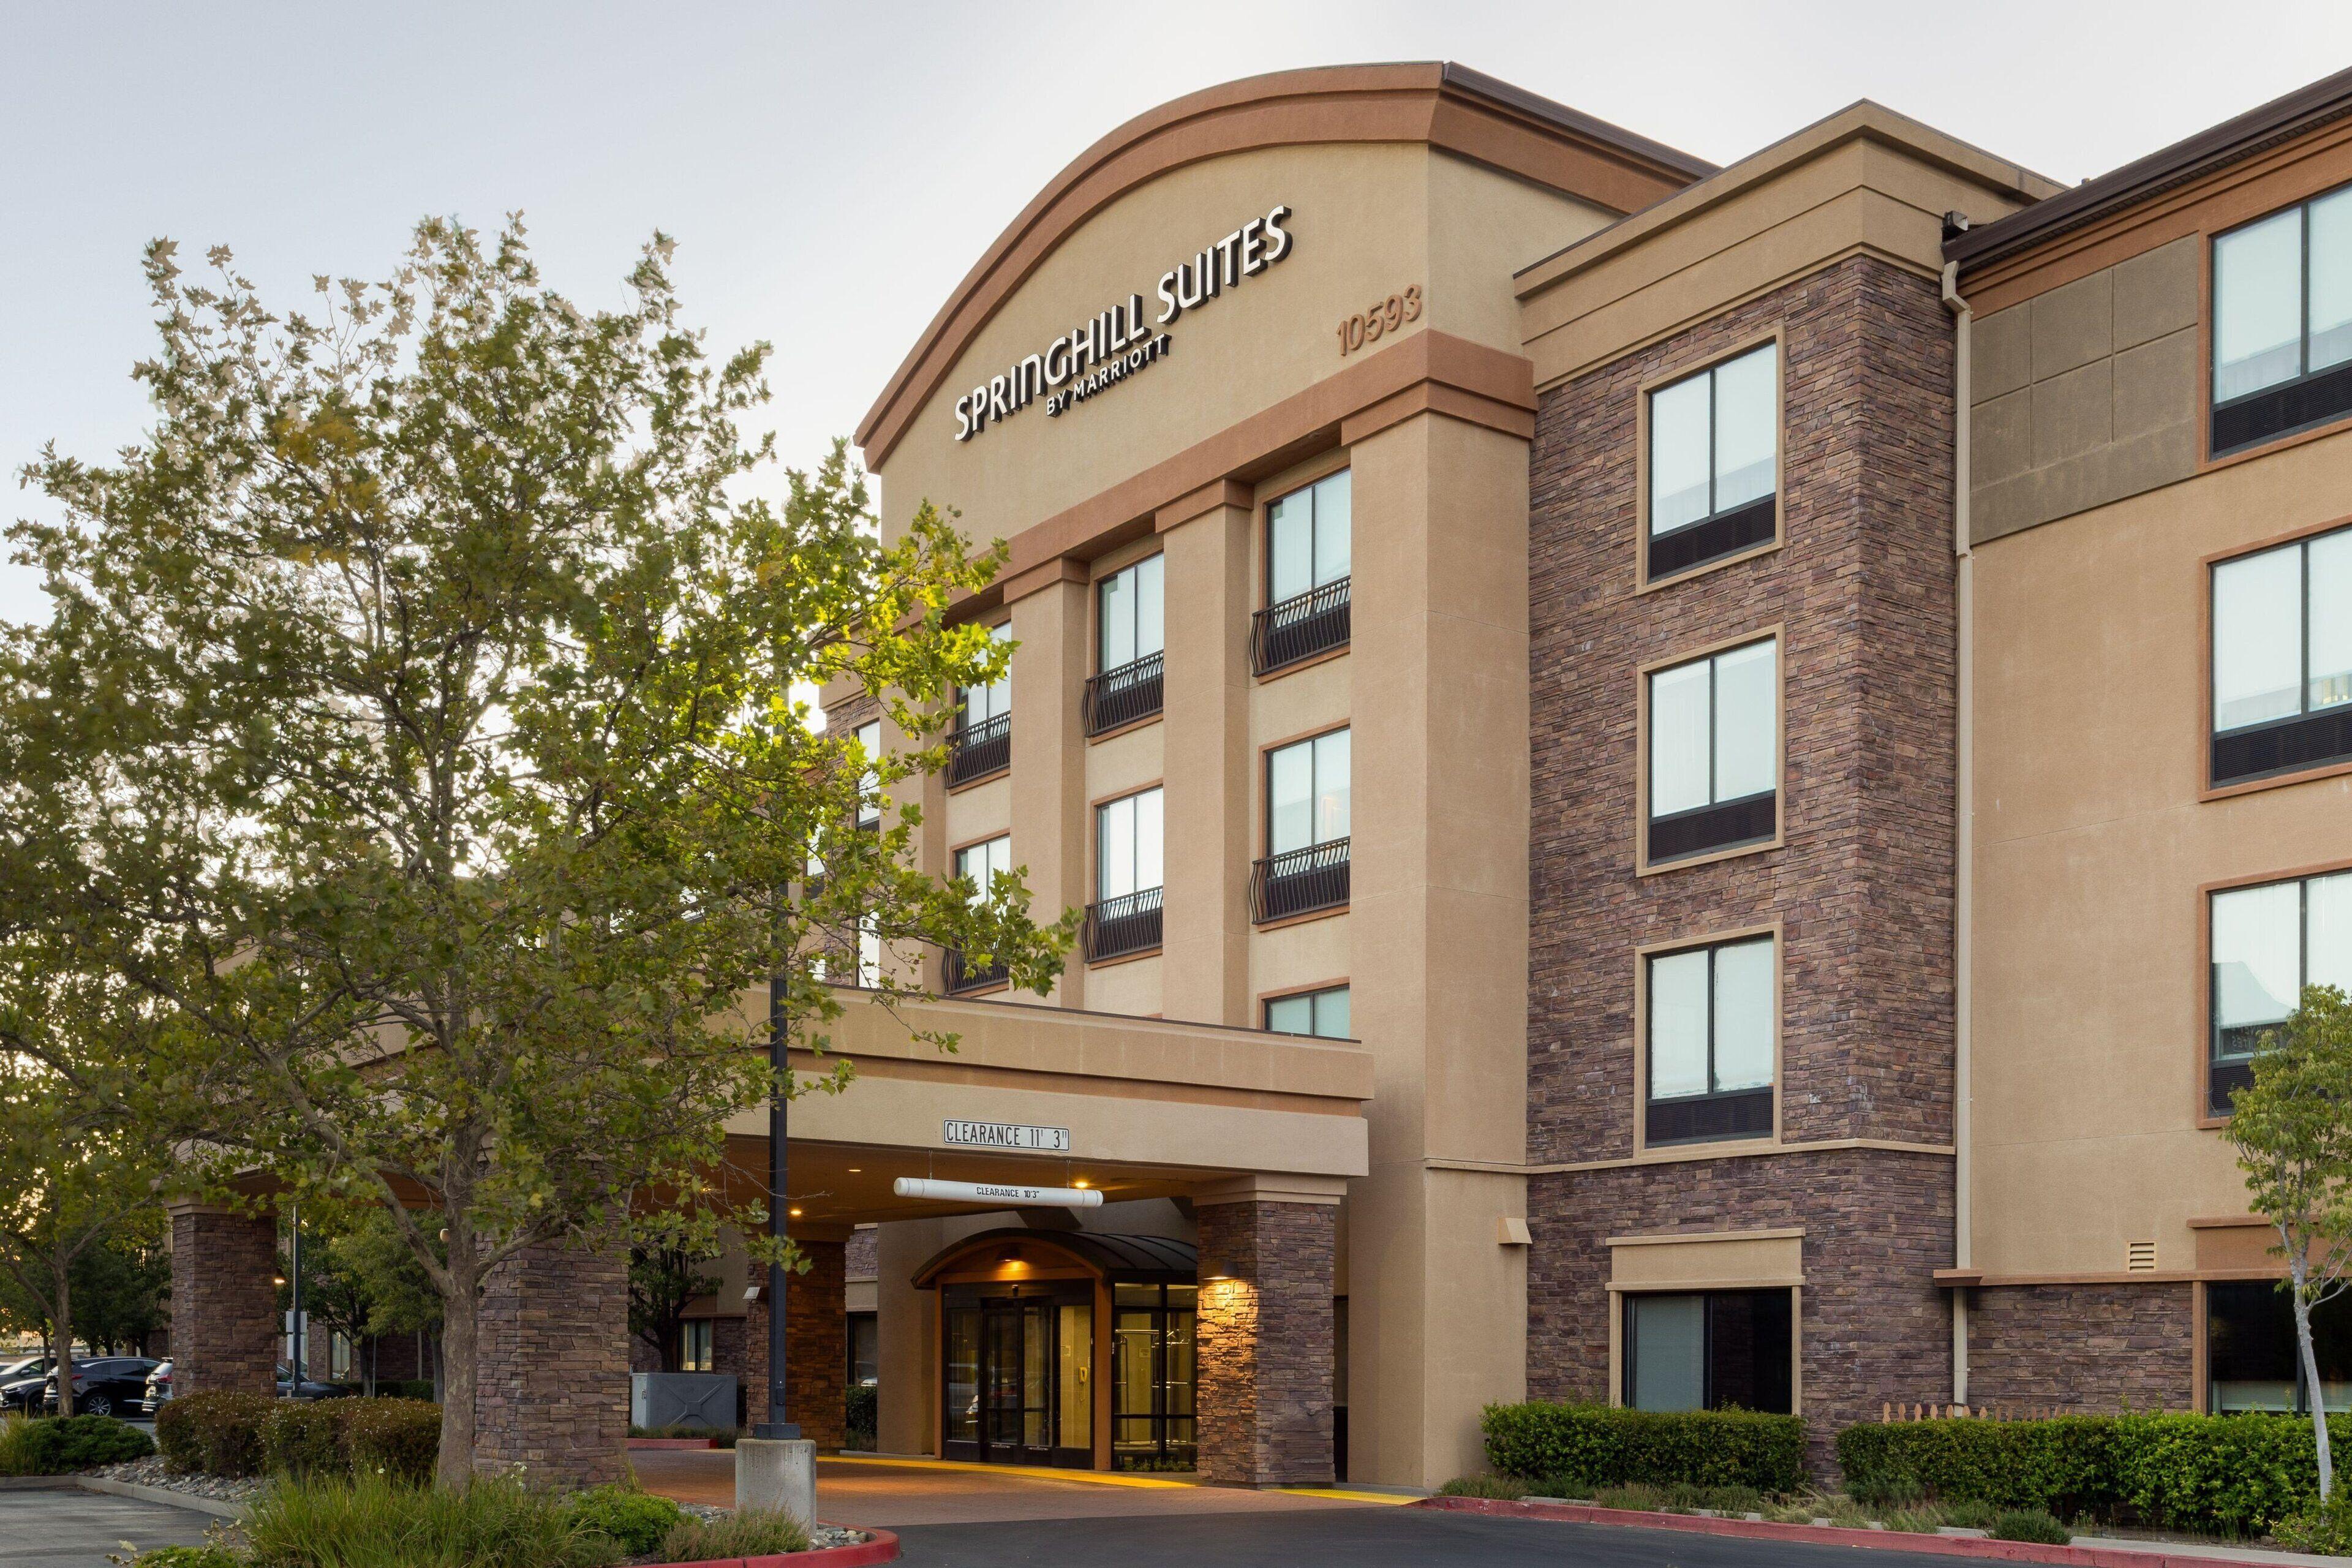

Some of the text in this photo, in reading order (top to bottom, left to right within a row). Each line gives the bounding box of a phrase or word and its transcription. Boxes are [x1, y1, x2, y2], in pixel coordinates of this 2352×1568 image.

[954, 205, 1292, 441] SPRINGHILL SUITES
[1334, 284, 1422, 356] 10593
[1046, 333, 1170, 418] BY MARRIOTT
[946, 1122, 1067, 1148] CLEARANCE 11' 3"
[976, 1186, 1040, 1199] CLEARANCE 10'3"
